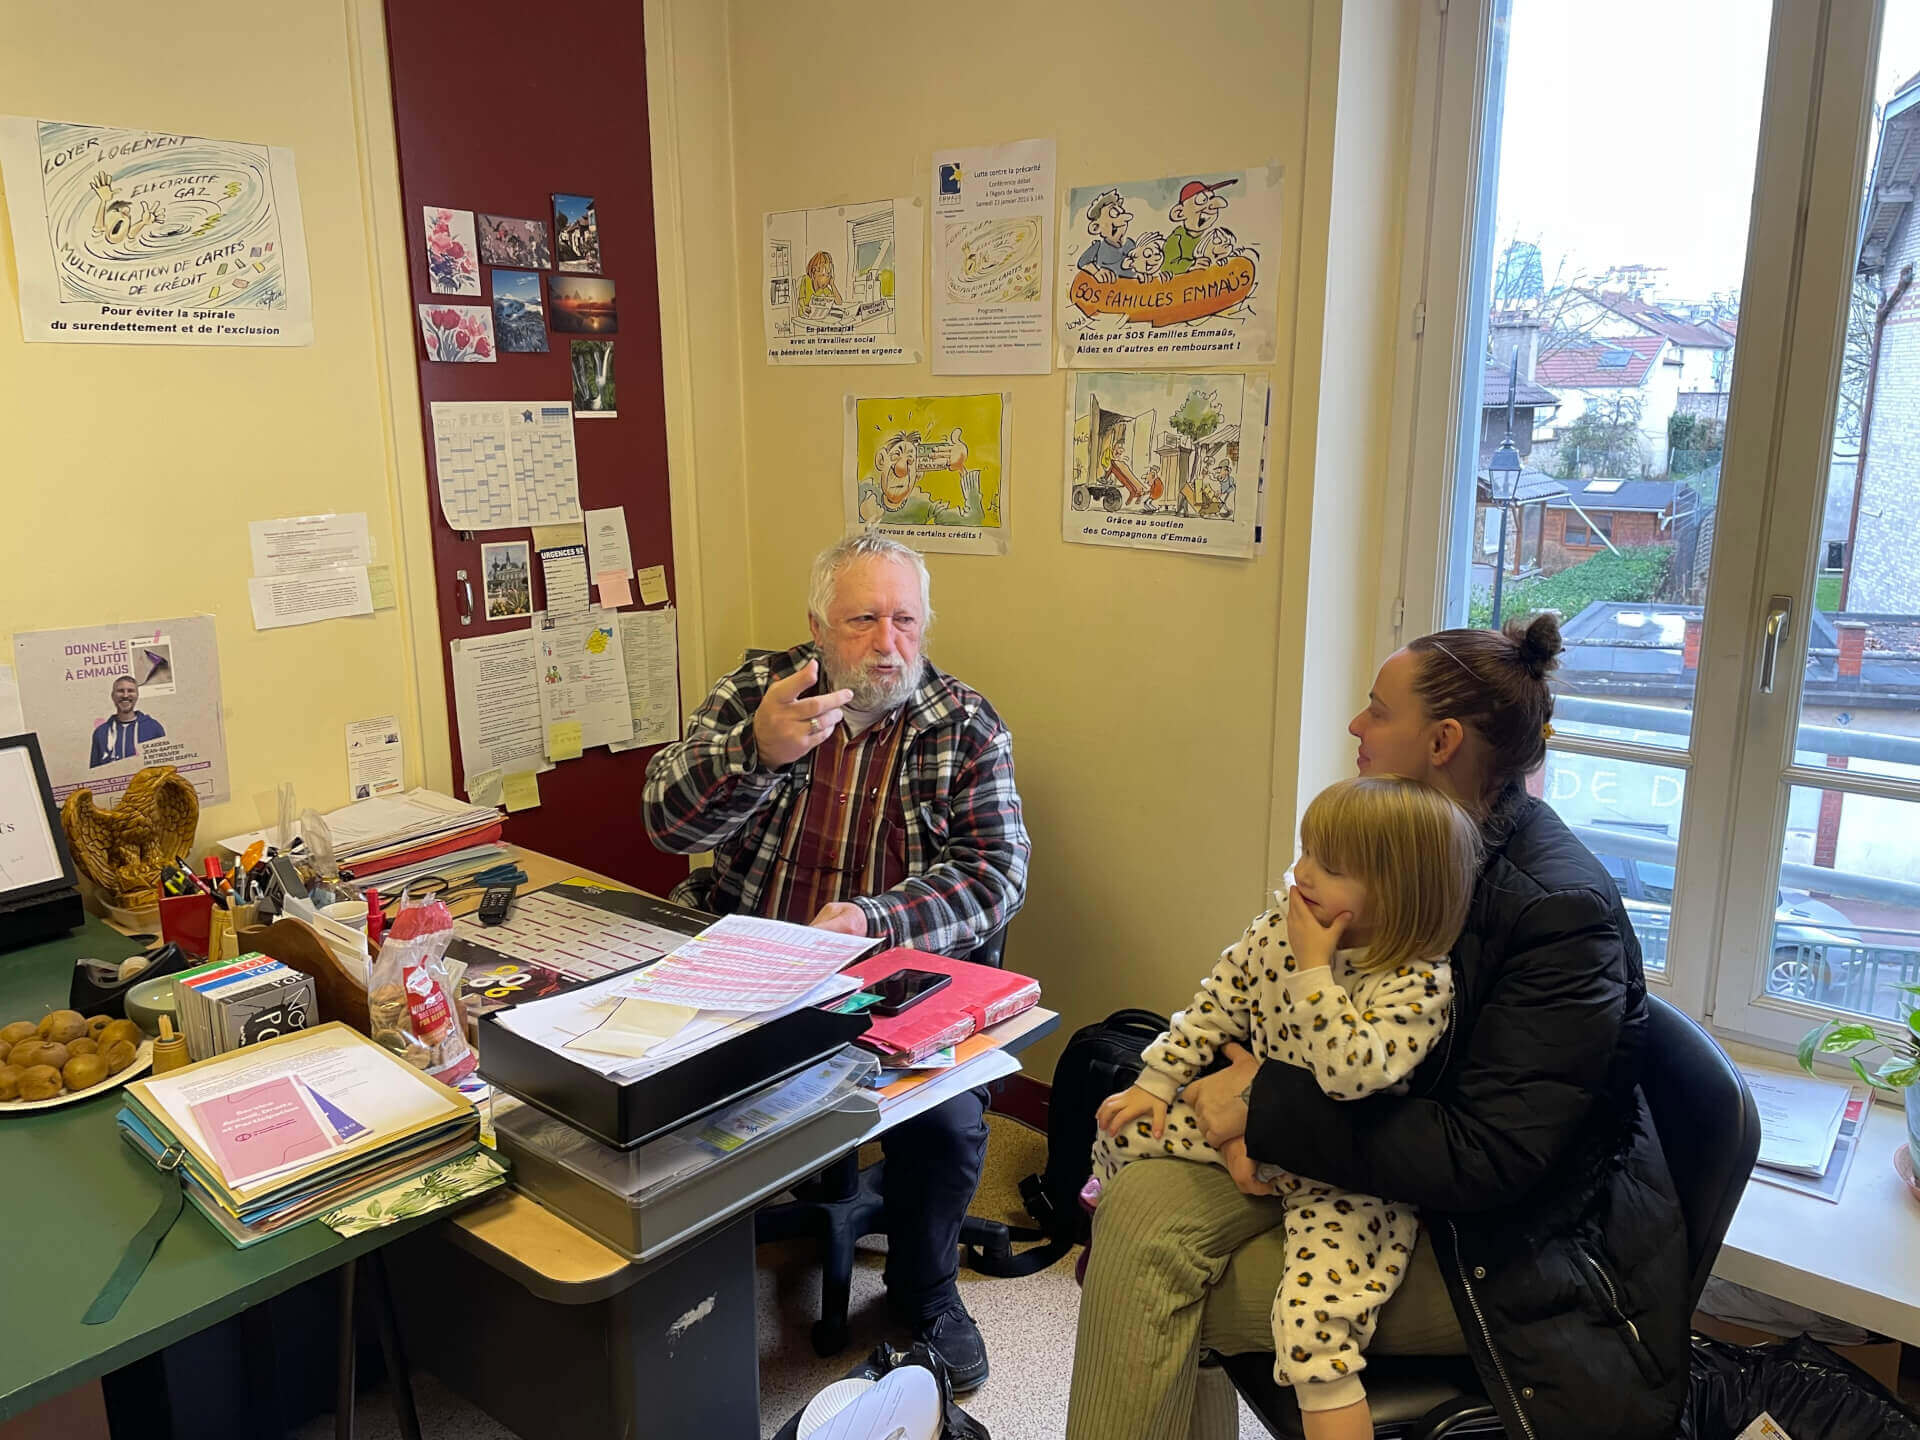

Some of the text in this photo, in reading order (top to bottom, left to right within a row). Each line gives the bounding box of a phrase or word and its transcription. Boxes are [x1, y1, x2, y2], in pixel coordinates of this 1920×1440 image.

[44, 137, 100, 175] LOYER
[97, 136, 193, 162] LOGEMENT
[174, 186, 212, 199] GAZ
[61, 240, 245, 282] MULTIPLICATION DE CARTES
[128, 272, 208, 297] DE CRÉDIT
[1075, 270, 1250, 308] SOS FAMILLES EMMAÜS
[101, 306, 236, 321] Pour éviter la spirale
[51, 320, 280, 335] du surendettement et de l'exclusion
[817, 326, 856, 335] partenariat
[817, 336, 853, 345] travailleur
[854, 336, 876, 344] social
[1106, 332, 1123, 342] par
[1125, 331, 1145, 339] SOS
[1147, 330, 1189, 339] Familles
[1191, 329, 1236, 339] Emmaüs,
[769, 349, 779, 357] les
[780, 348, 814, 357] bénévoles
[815, 348, 860, 357] interviennent
[872, 347, 904, 357] urgence
[1076, 345, 1101, 355] Aidez
[1116, 344, 1154, 354] d'autres
[1157, 345, 1169, 353] en
[1171, 343, 1234, 352] remboursant
[1106, 515, 1184, 529] Grâce au soutien
[916, 530, 946, 538] certains
[948, 530, 977, 539] crédits
[1082, 527, 1209, 544] des Compagnons d'Emmaüs
[64, 640, 127, 656] DONNE-LE
[84, 651, 128, 667] PLUTÔT
[65, 664, 129, 681] À EMMAÜS
[1552, 769, 1617, 804] DE
[245, 962, 279, 977] POP
[272, 972, 304, 988] POP
